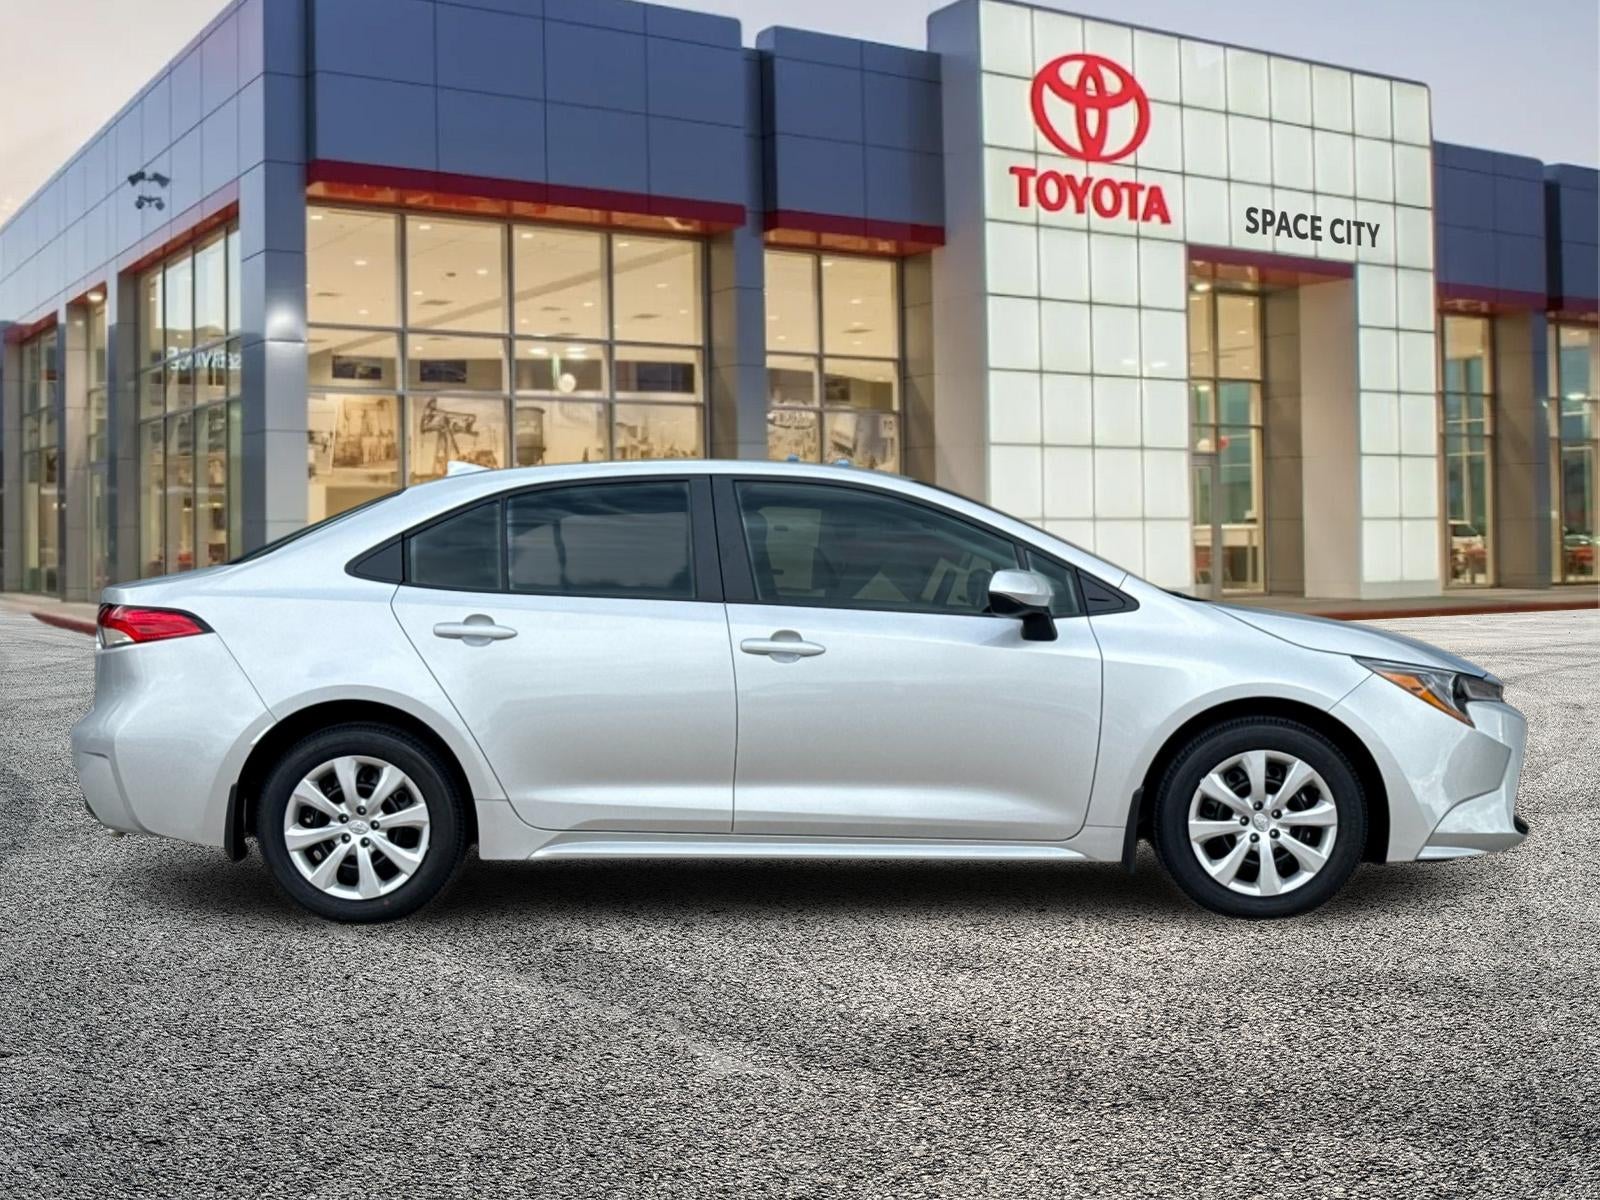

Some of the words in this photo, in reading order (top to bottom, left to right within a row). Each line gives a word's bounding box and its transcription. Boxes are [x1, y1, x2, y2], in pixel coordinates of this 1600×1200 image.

[1009, 166, 1171, 224] TOYOTA
[1245, 206, 1323, 242] SPACE
[1329, 217, 1380, 248] CITY
